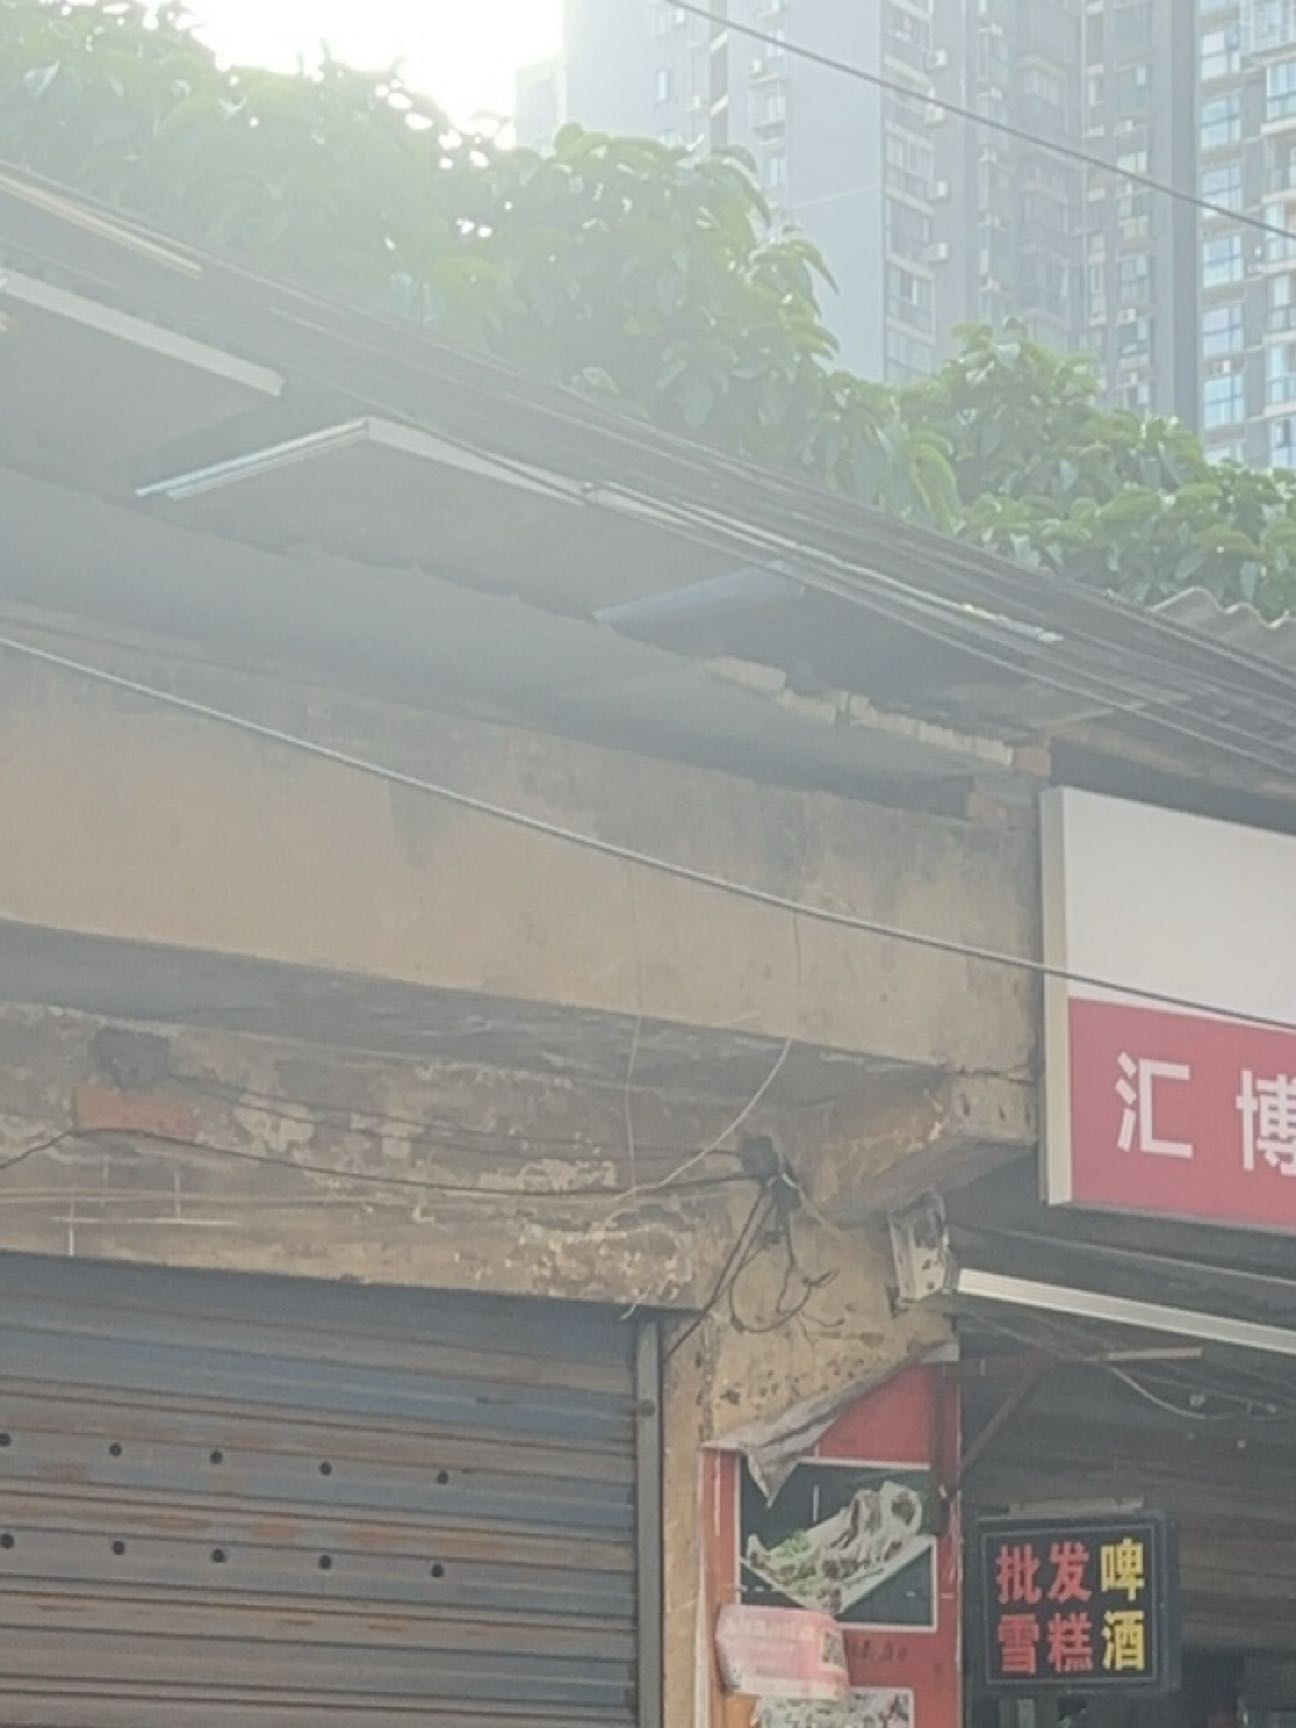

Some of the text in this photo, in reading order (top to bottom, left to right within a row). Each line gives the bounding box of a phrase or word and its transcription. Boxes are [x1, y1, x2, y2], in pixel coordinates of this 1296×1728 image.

[996, 1540, 1092, 1605] 批发
[1099, 1537, 1147, 1673] 啤酒
[998, 1613, 1094, 1675] 雪糕
